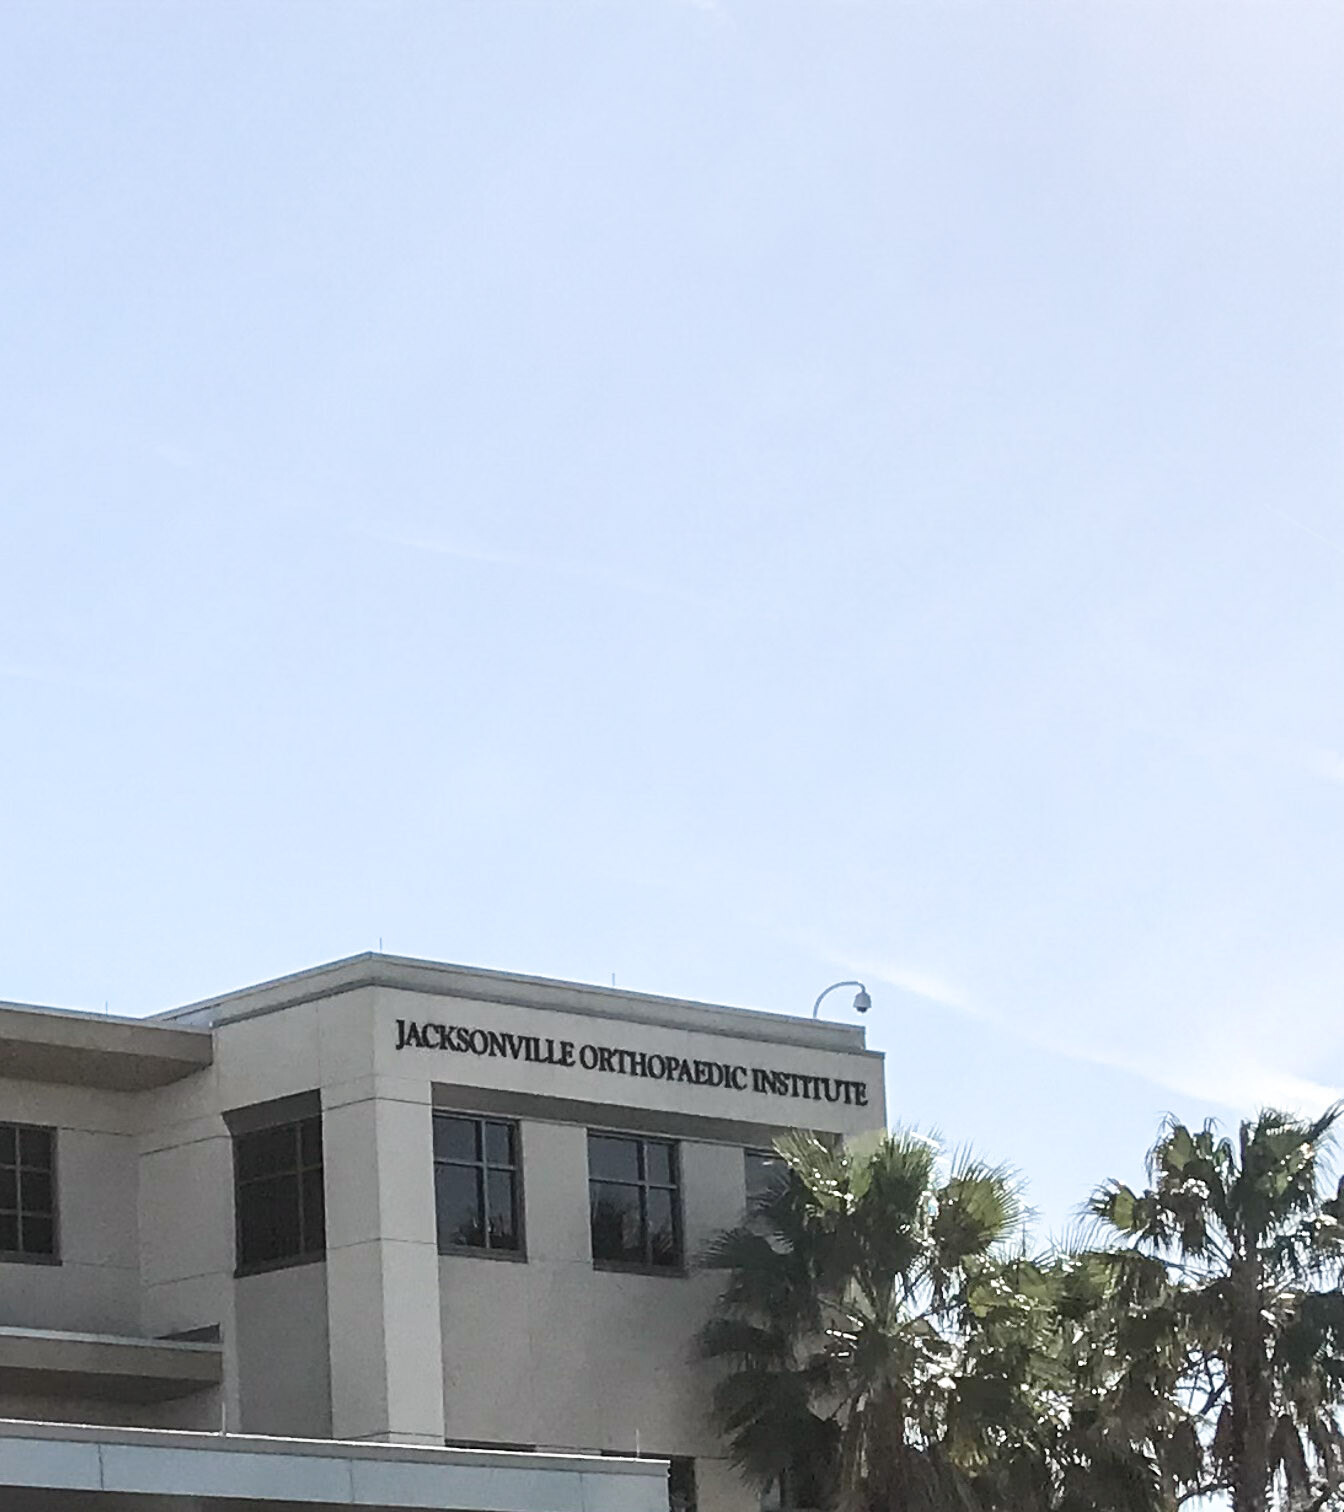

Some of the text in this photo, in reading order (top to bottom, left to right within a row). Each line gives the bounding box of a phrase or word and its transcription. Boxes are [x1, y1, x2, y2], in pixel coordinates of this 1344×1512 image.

[395, 1019, 869, 1106] JACKSONVILLE ORTHOPAEDIC INSTITUTE
